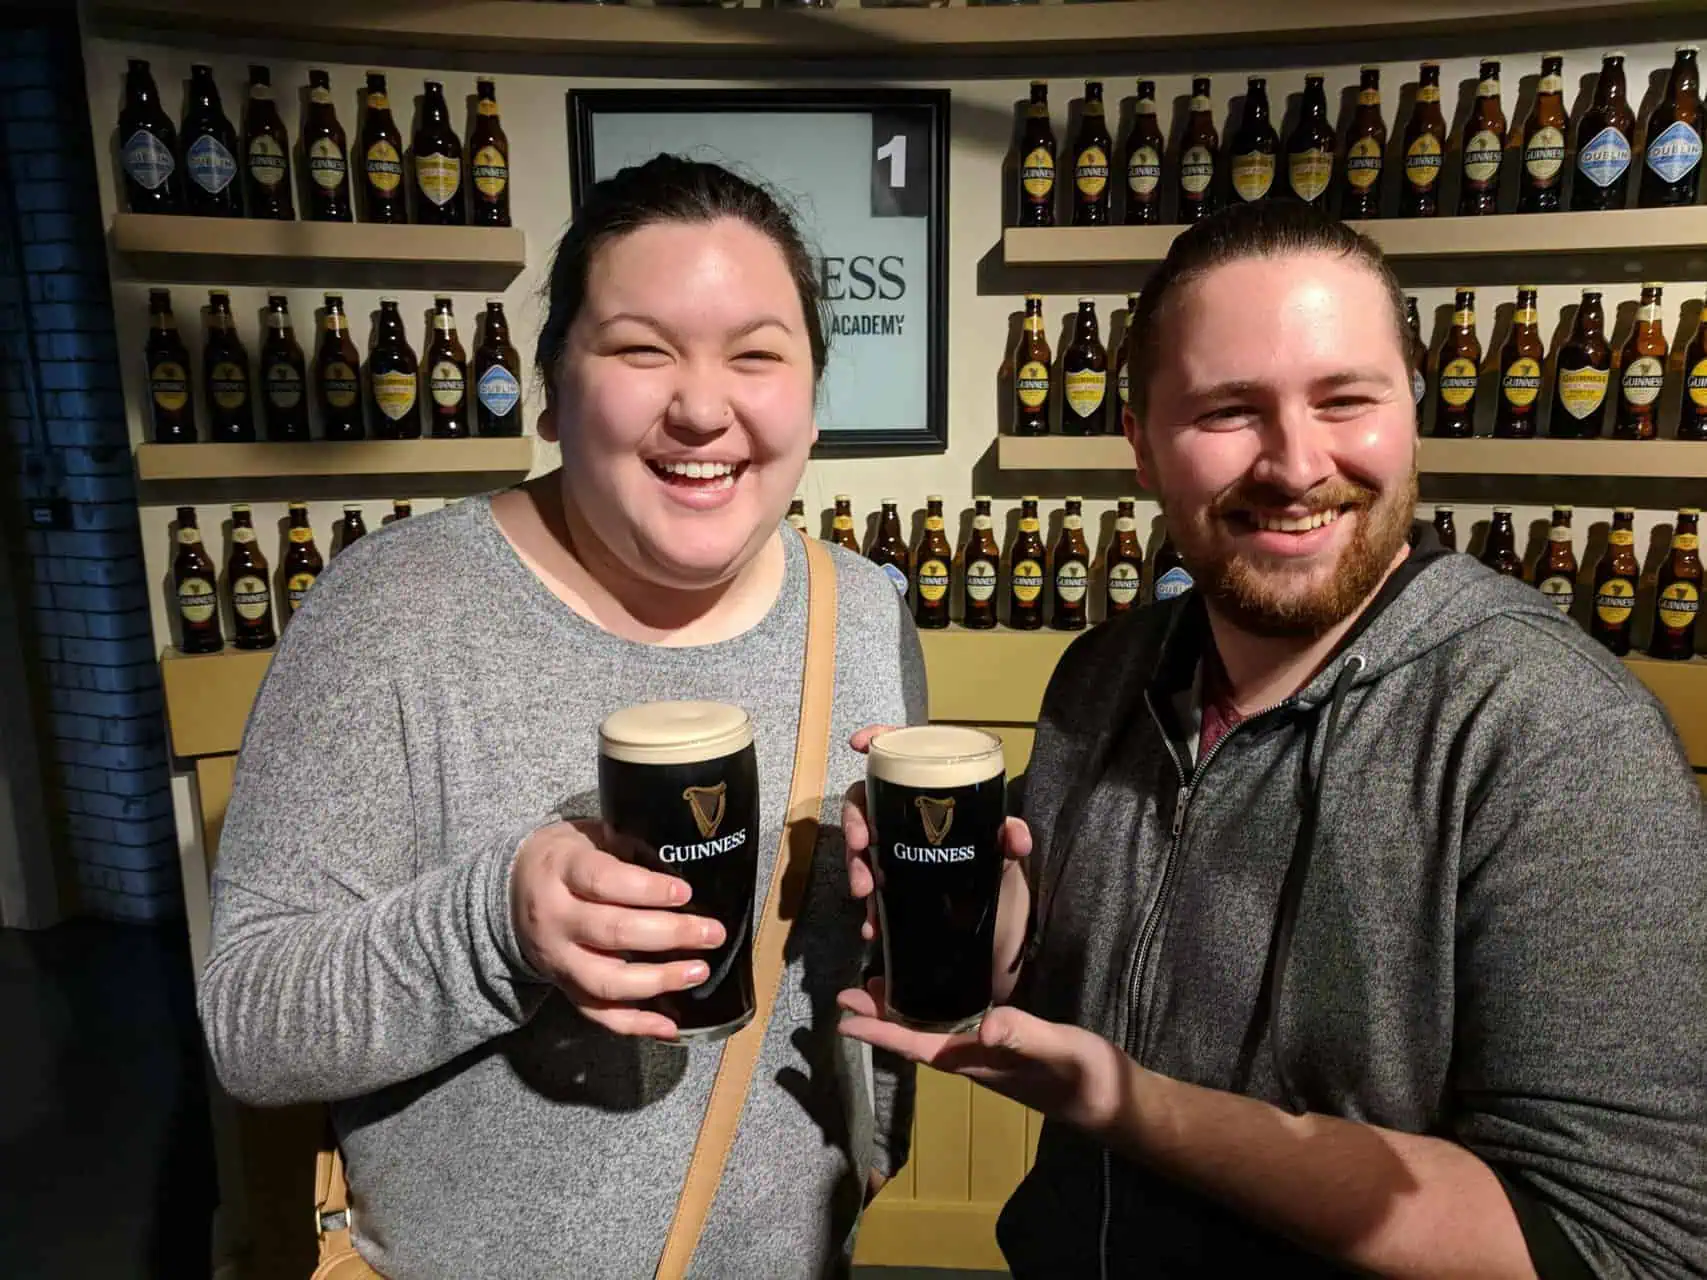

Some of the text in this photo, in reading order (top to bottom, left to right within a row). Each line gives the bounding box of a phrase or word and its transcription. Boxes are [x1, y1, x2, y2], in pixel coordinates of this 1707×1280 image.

[877, 135, 908, 188] 1
[821, 256, 906, 301] ESS
[832, 315, 905, 336] ACADEMY
[658, 828, 747, 863] GUINNESS
[894, 842, 976, 864] GUINNESS
